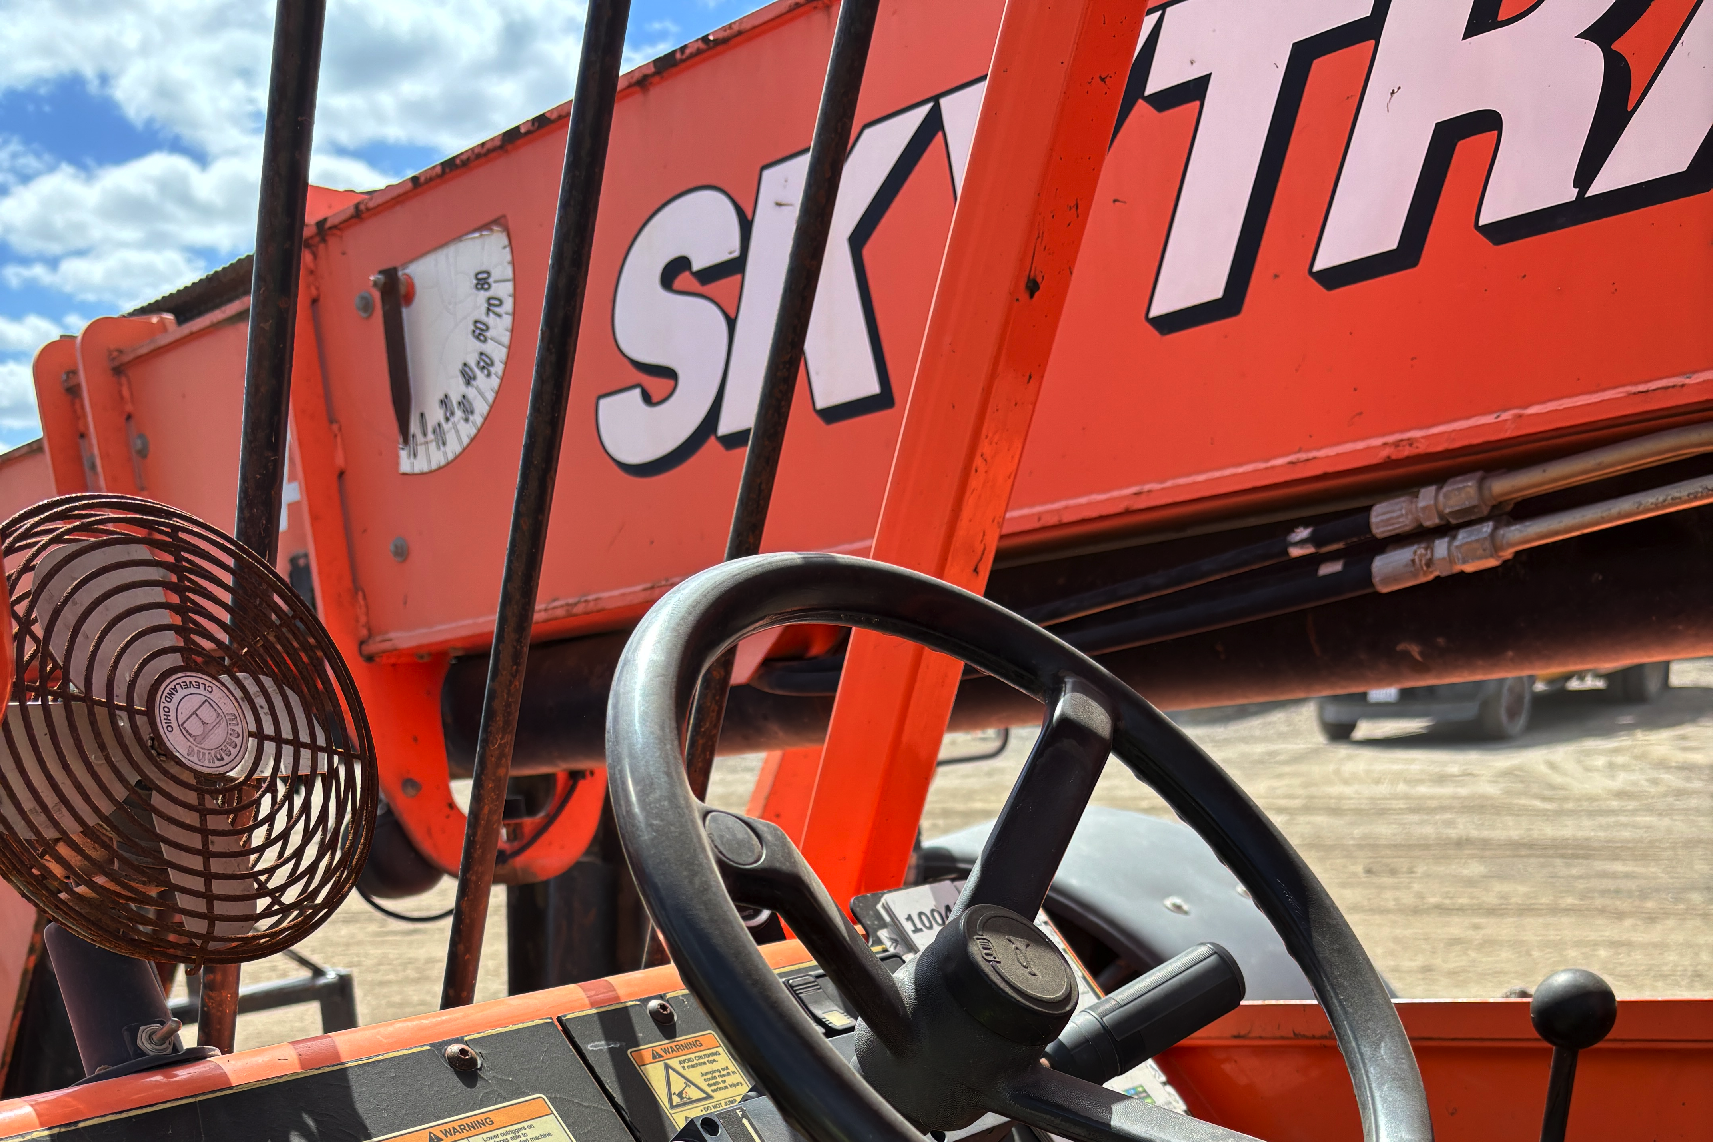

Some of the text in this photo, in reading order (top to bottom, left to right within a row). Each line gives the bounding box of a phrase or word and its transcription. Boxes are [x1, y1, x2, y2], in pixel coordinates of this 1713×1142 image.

[475, 270, 492, 292] 80
[486, 296, 504, 318] 70
[472, 320, 490, 344] 60
[459, 362, 477, 387] 40
[477, 352, 494, 378] 50
[440, 393, 456, 424] 20
[458, 394, 474, 424] 30
[432, 422, 448, 451] 10
[162, 680, 214, 733] CLEVELAND, OHIO
[661, 1040, 703, 1055] WARNING
[736, 1109, 744, 1118] F
[440, 1116, 494, 1138] WARNING
